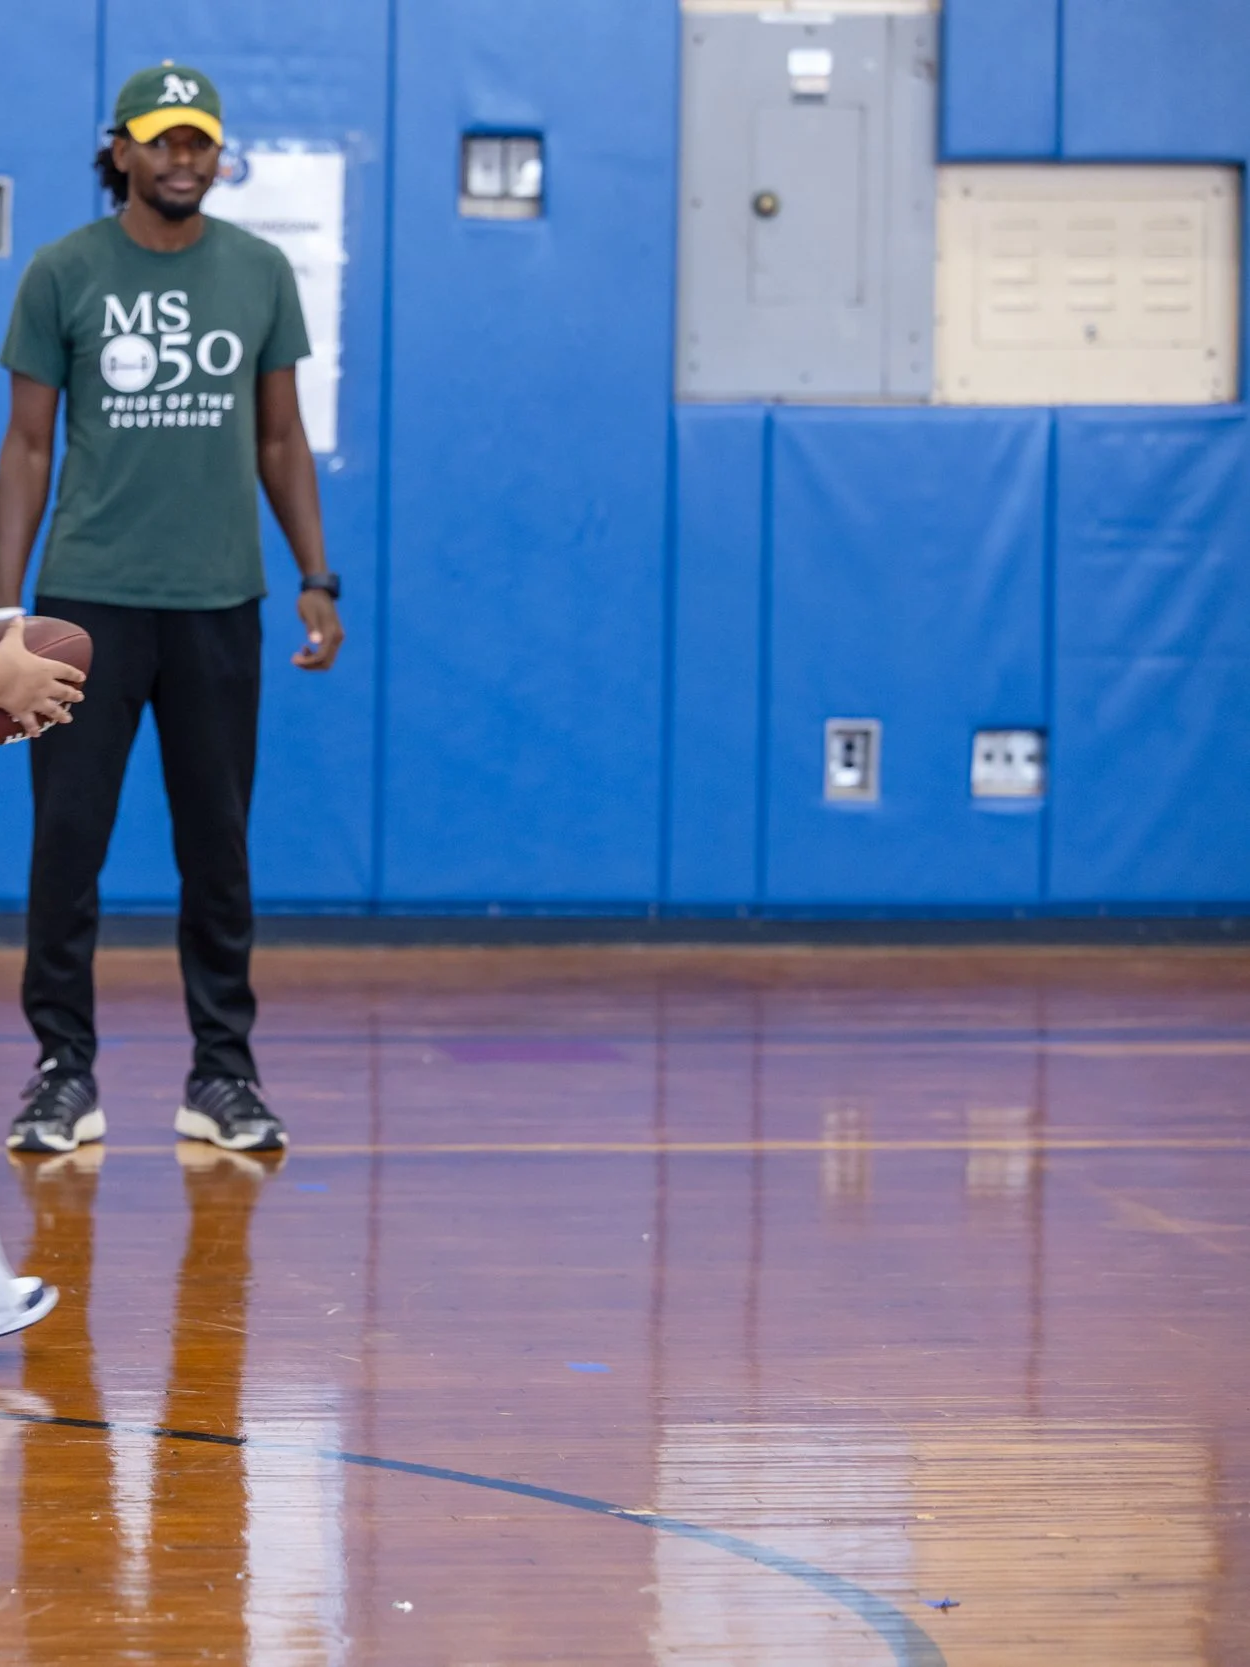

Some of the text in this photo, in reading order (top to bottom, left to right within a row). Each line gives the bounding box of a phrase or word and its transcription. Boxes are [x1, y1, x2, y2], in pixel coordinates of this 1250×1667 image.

[100, 290, 191, 337] MS
[101, 392, 235, 412] PRIDE OF THE
[109, 410, 222, 428] SOUTHSIDE
